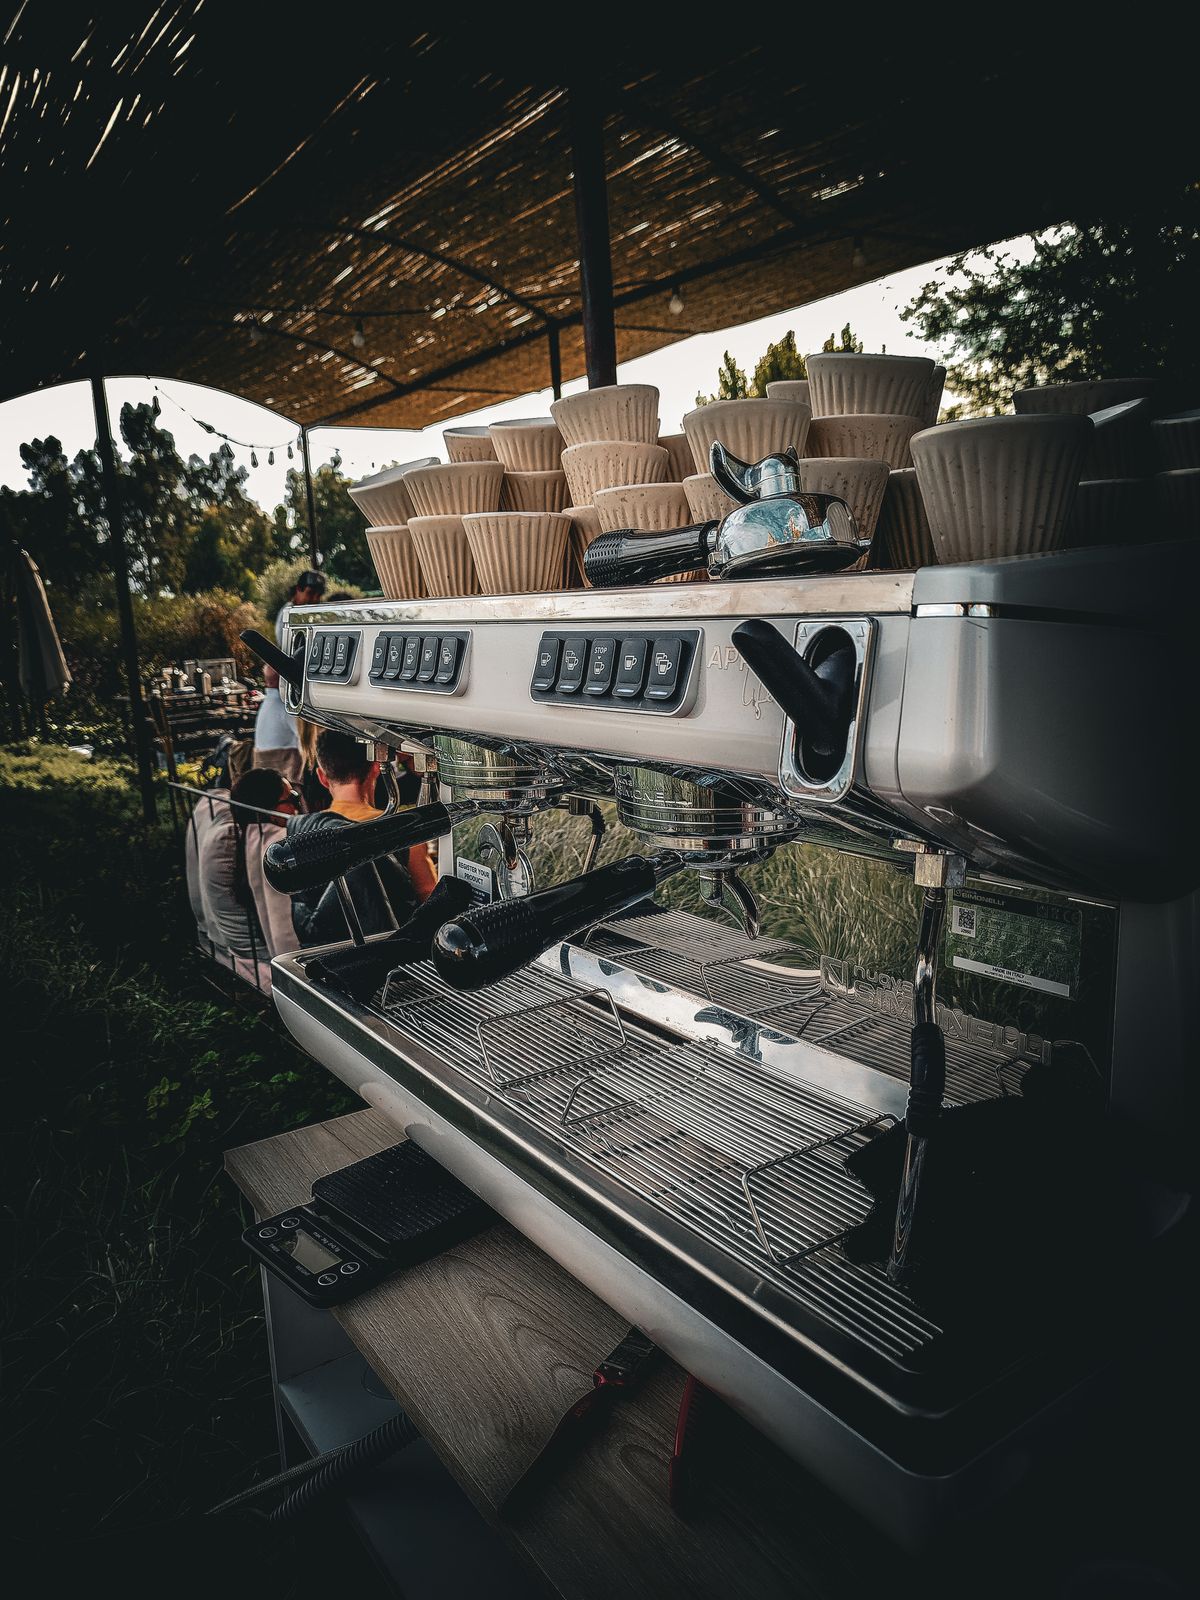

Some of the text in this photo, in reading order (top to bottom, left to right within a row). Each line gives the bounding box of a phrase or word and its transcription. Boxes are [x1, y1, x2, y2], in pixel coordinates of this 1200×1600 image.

[594, 646, 608, 654] STOP
[458, 861, 490, 878] REGISTER YOUR
[464, 872, 484, 884] PRODUCT
[854, 980, 1052, 1066] SIMNELLI
